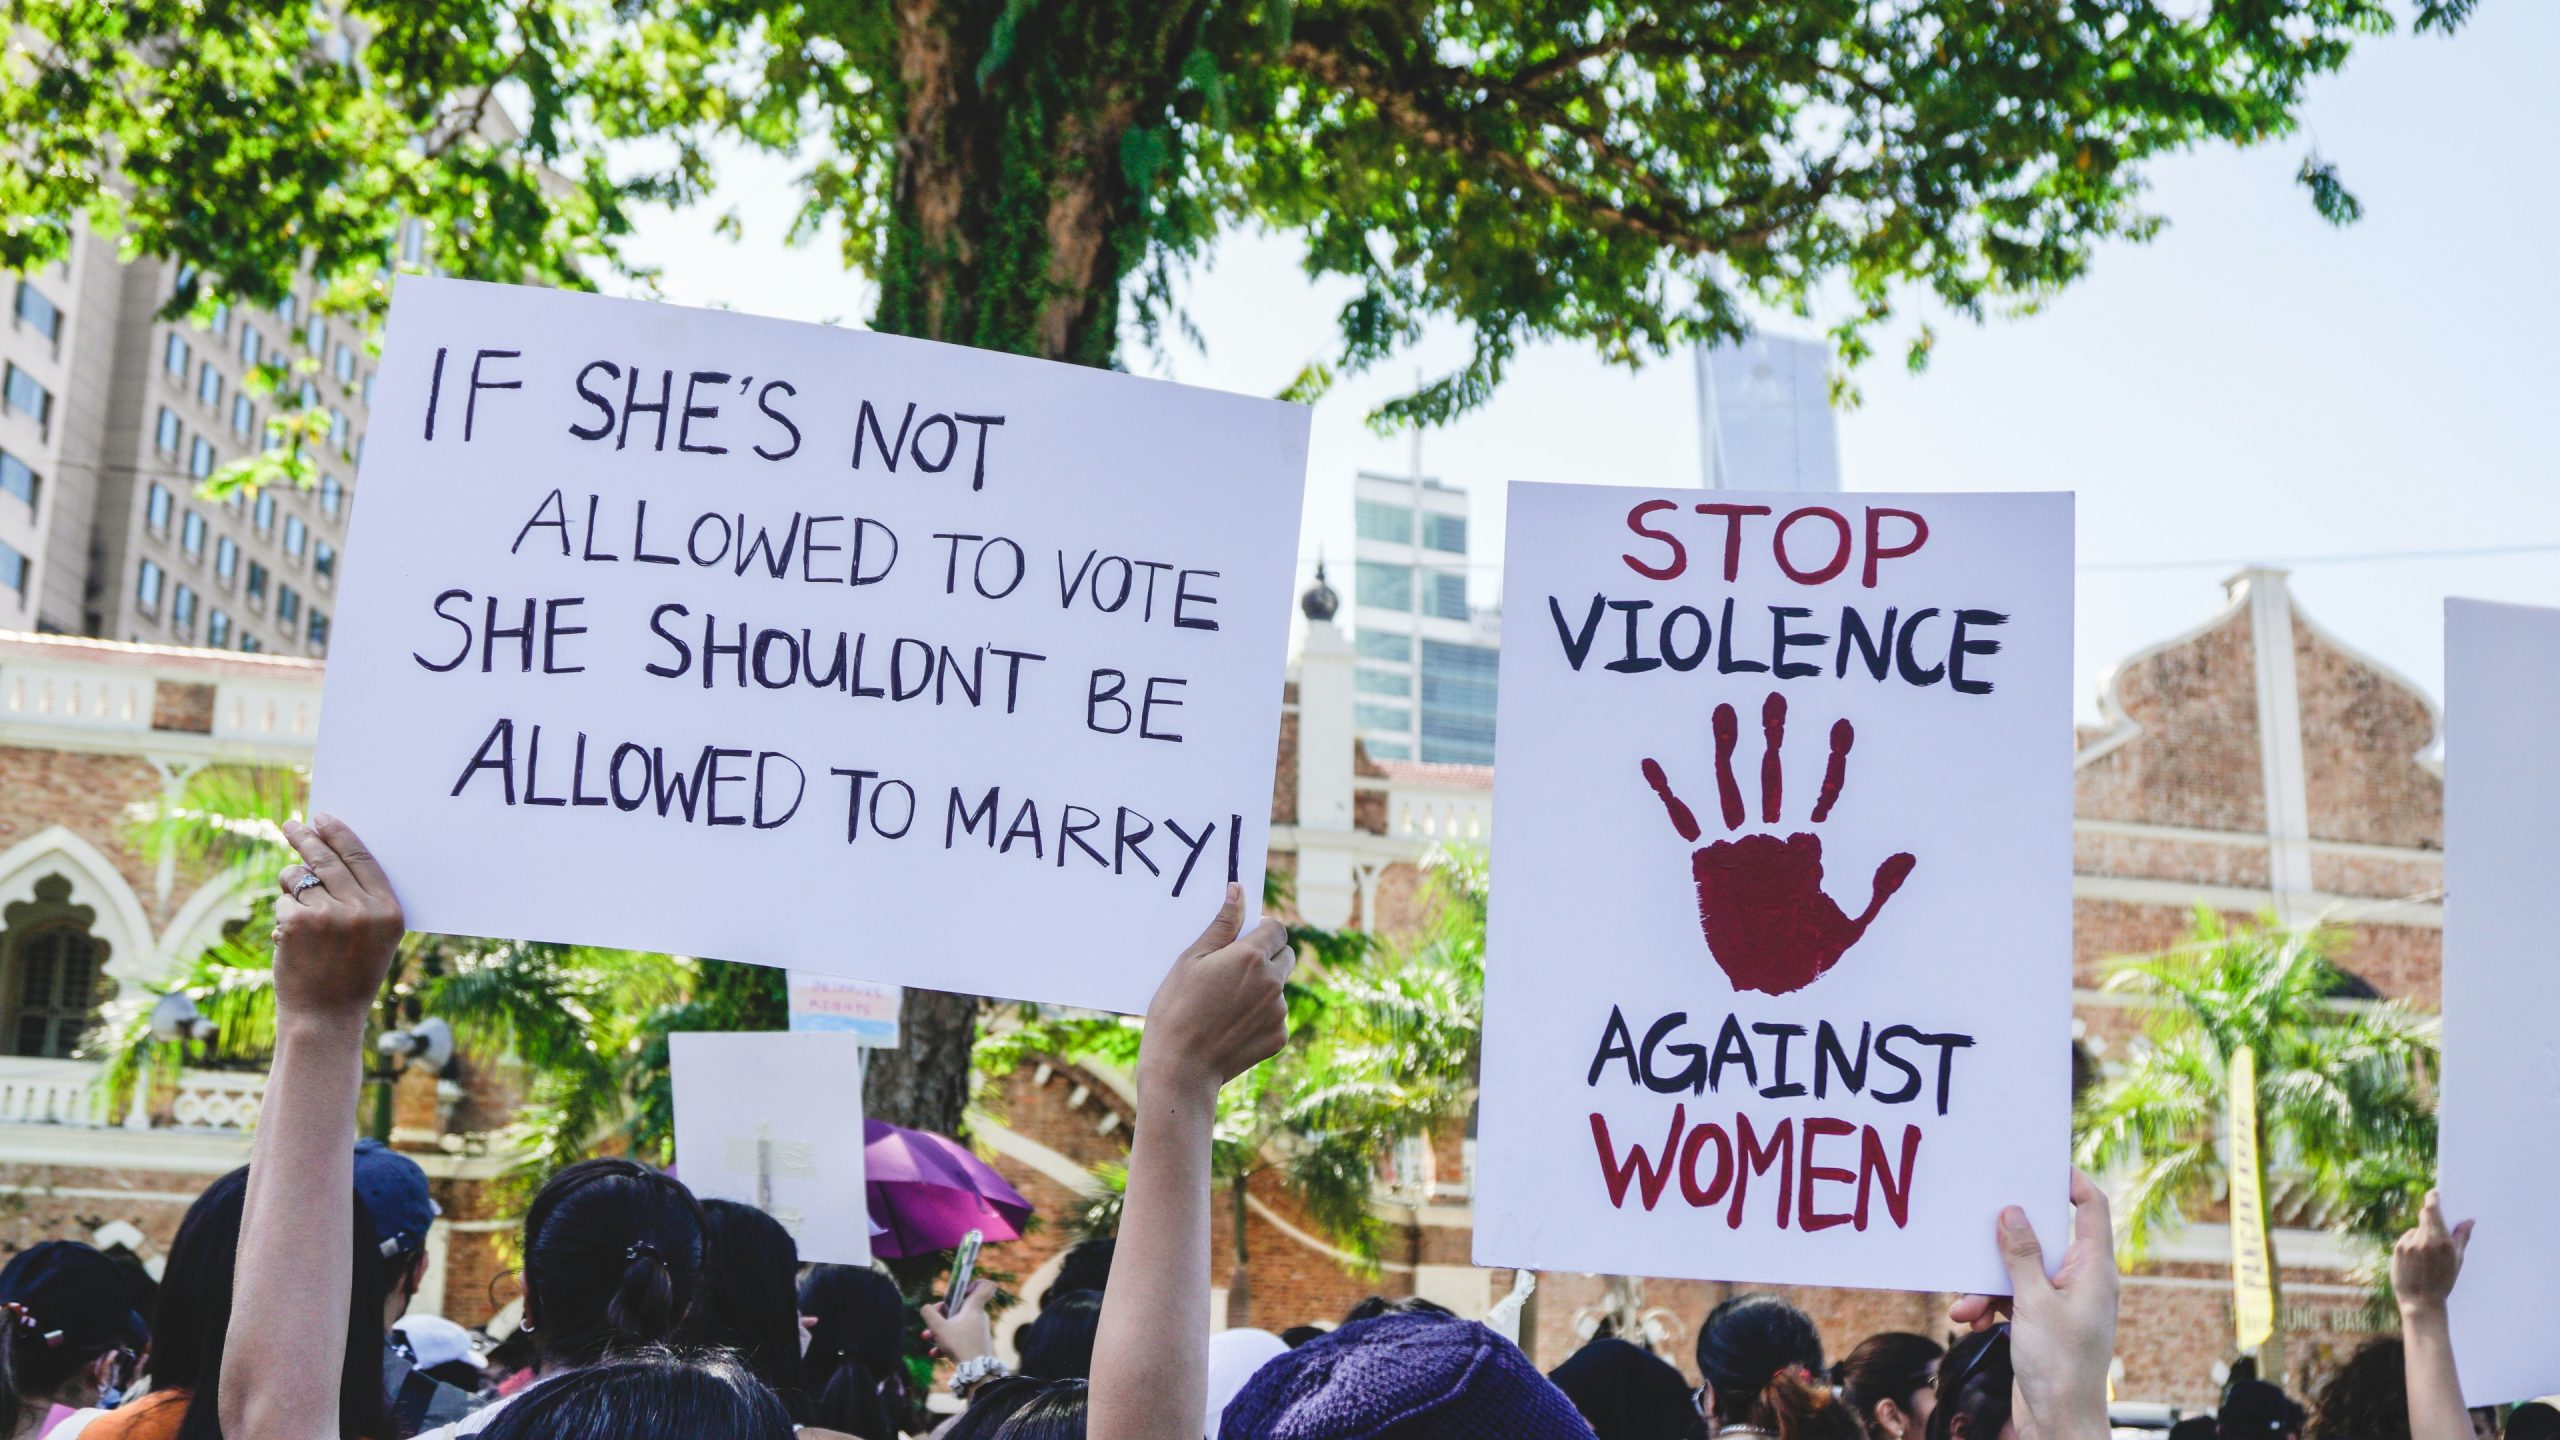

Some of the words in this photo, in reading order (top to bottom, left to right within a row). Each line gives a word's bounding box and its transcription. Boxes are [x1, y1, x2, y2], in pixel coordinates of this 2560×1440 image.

[425, 349, 522, 441] IF
[570, 361, 801, 461] SHE'S
[853, 400, 1005, 491] NOT
[512, 490, 898, 586] ALLOWED
[933, 534, 1025, 598] TO
[1059, 550, 1219, 631] VOTE
[1623, 500, 1928, 587] STOP
[413, 590, 587, 674] SHE
[646, 603, 1046, 713] SHOULDN'T
[1087, 669, 1187, 742] BE
[1549, 593, 2009, 694] VIOLENCE
[452, 719, 805, 829] ALLOWED
[831, 768, 915, 844] TO
[1588, 1005, 1976, 1116] AGAINST
[1590, 1103, 1922, 1231] WOMEN
